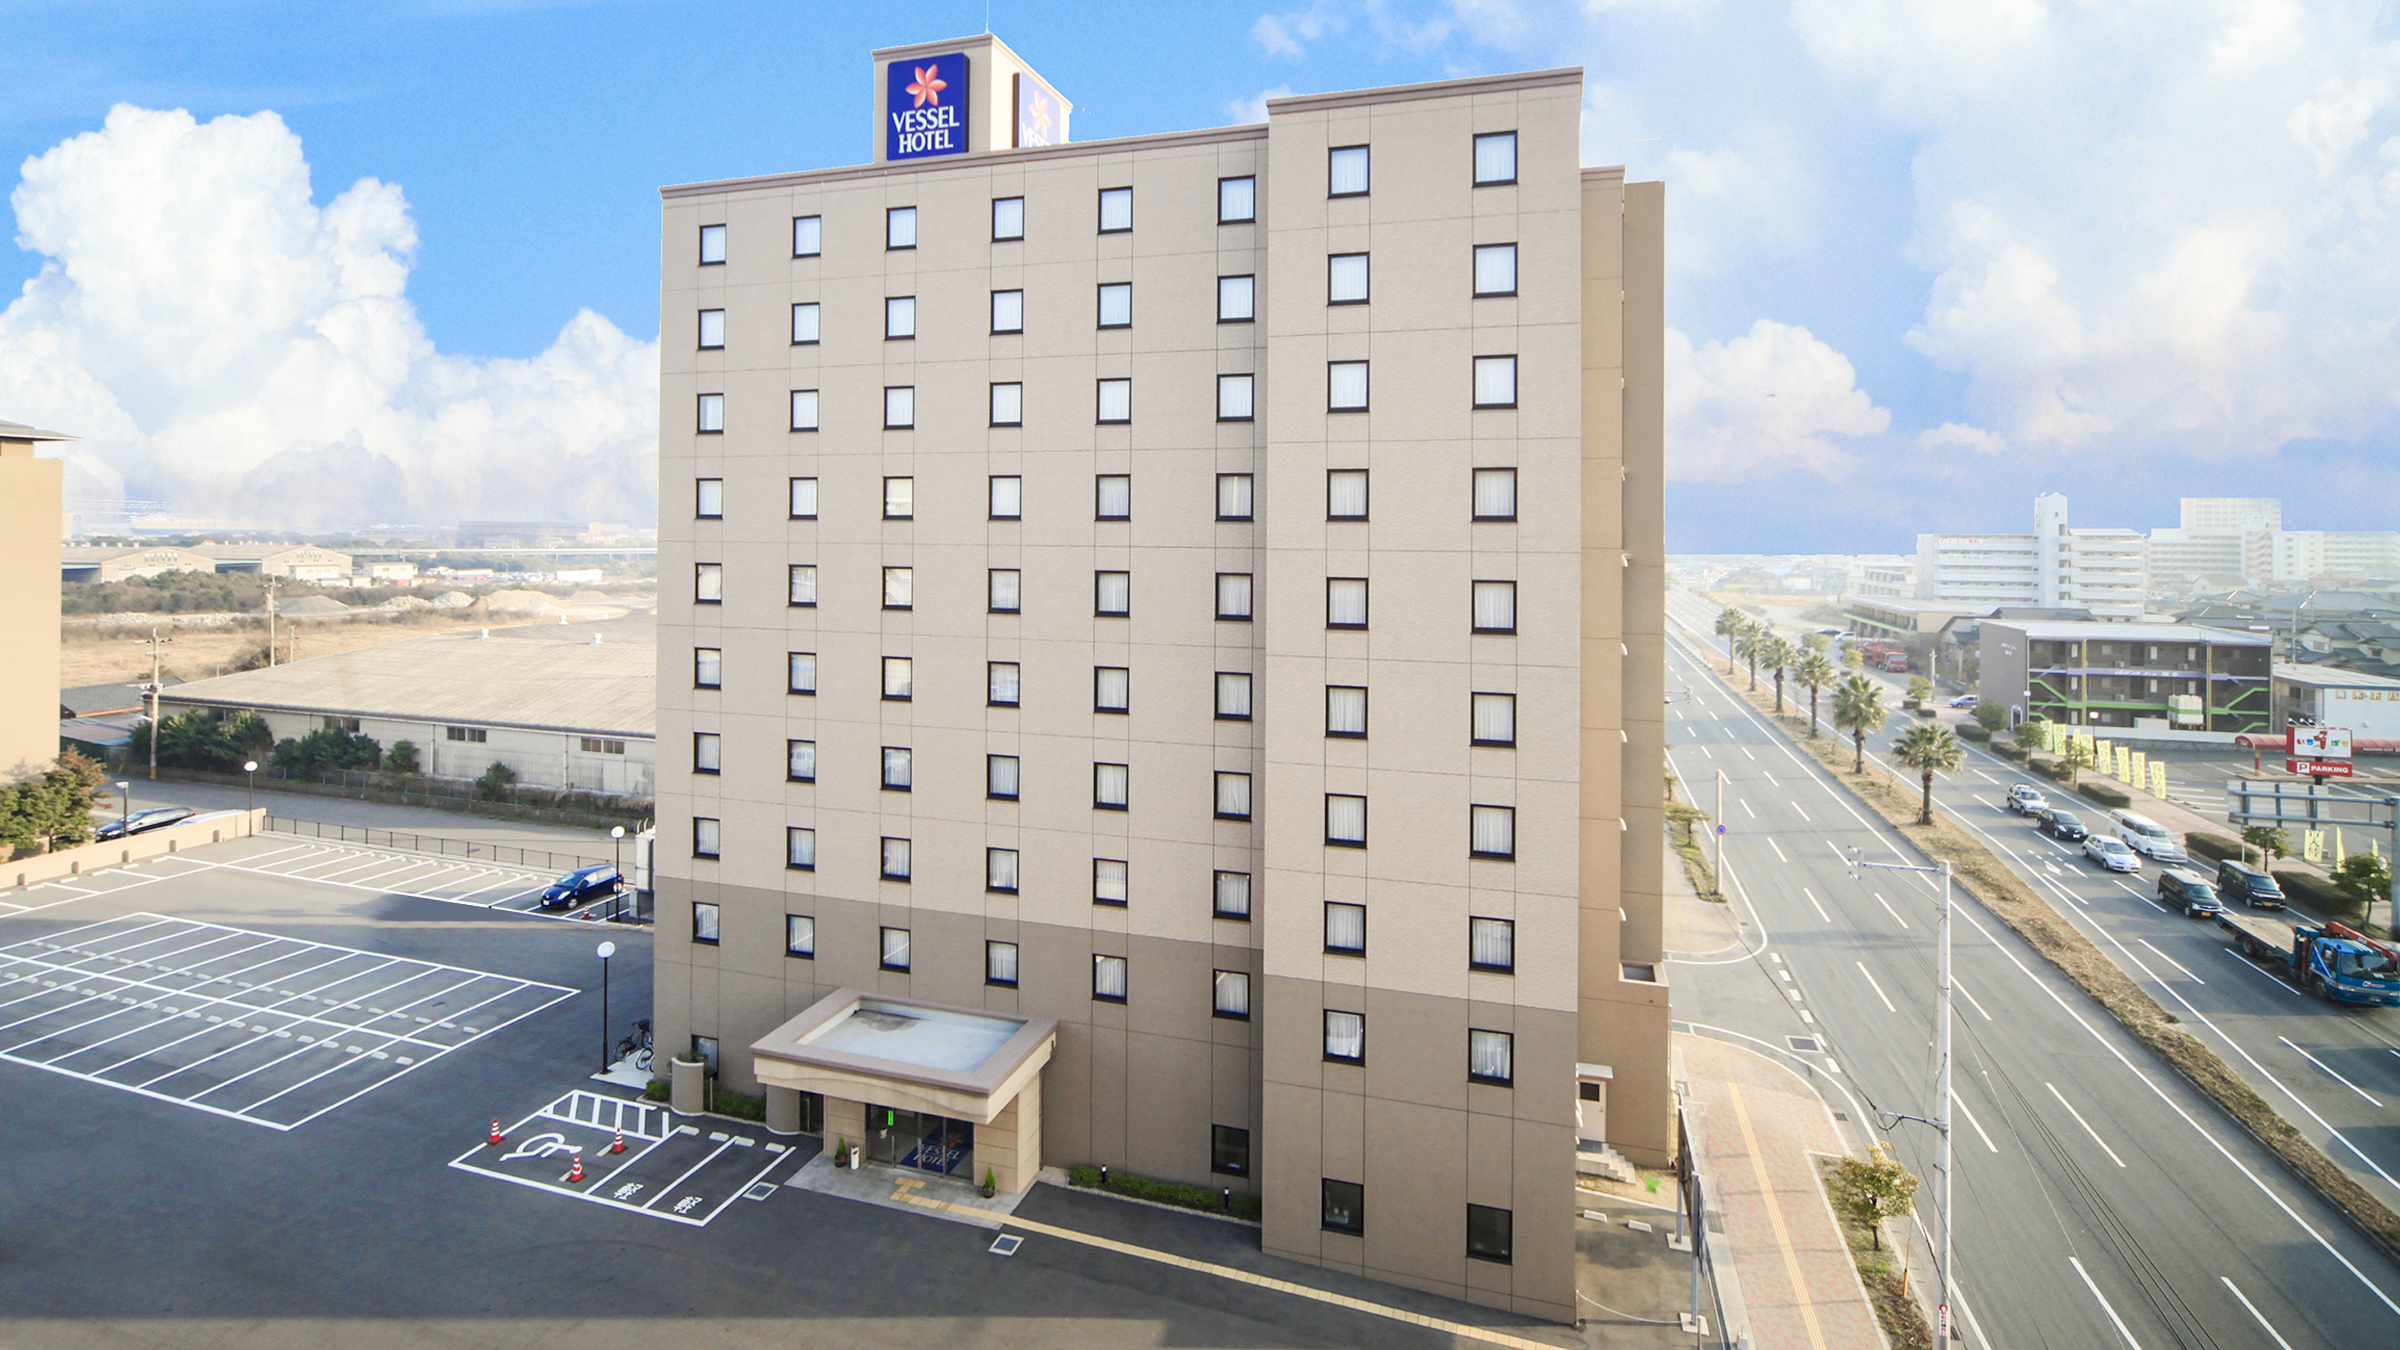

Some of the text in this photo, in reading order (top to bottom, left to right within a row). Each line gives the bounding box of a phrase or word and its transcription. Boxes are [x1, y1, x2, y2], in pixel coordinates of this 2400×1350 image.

[892, 105, 960, 133] VESSEL
[898, 129, 954, 154] HOTEL
[2310, 765, 2349, 774] PARKING
[921, 1144, 961, 1160] VESEL
